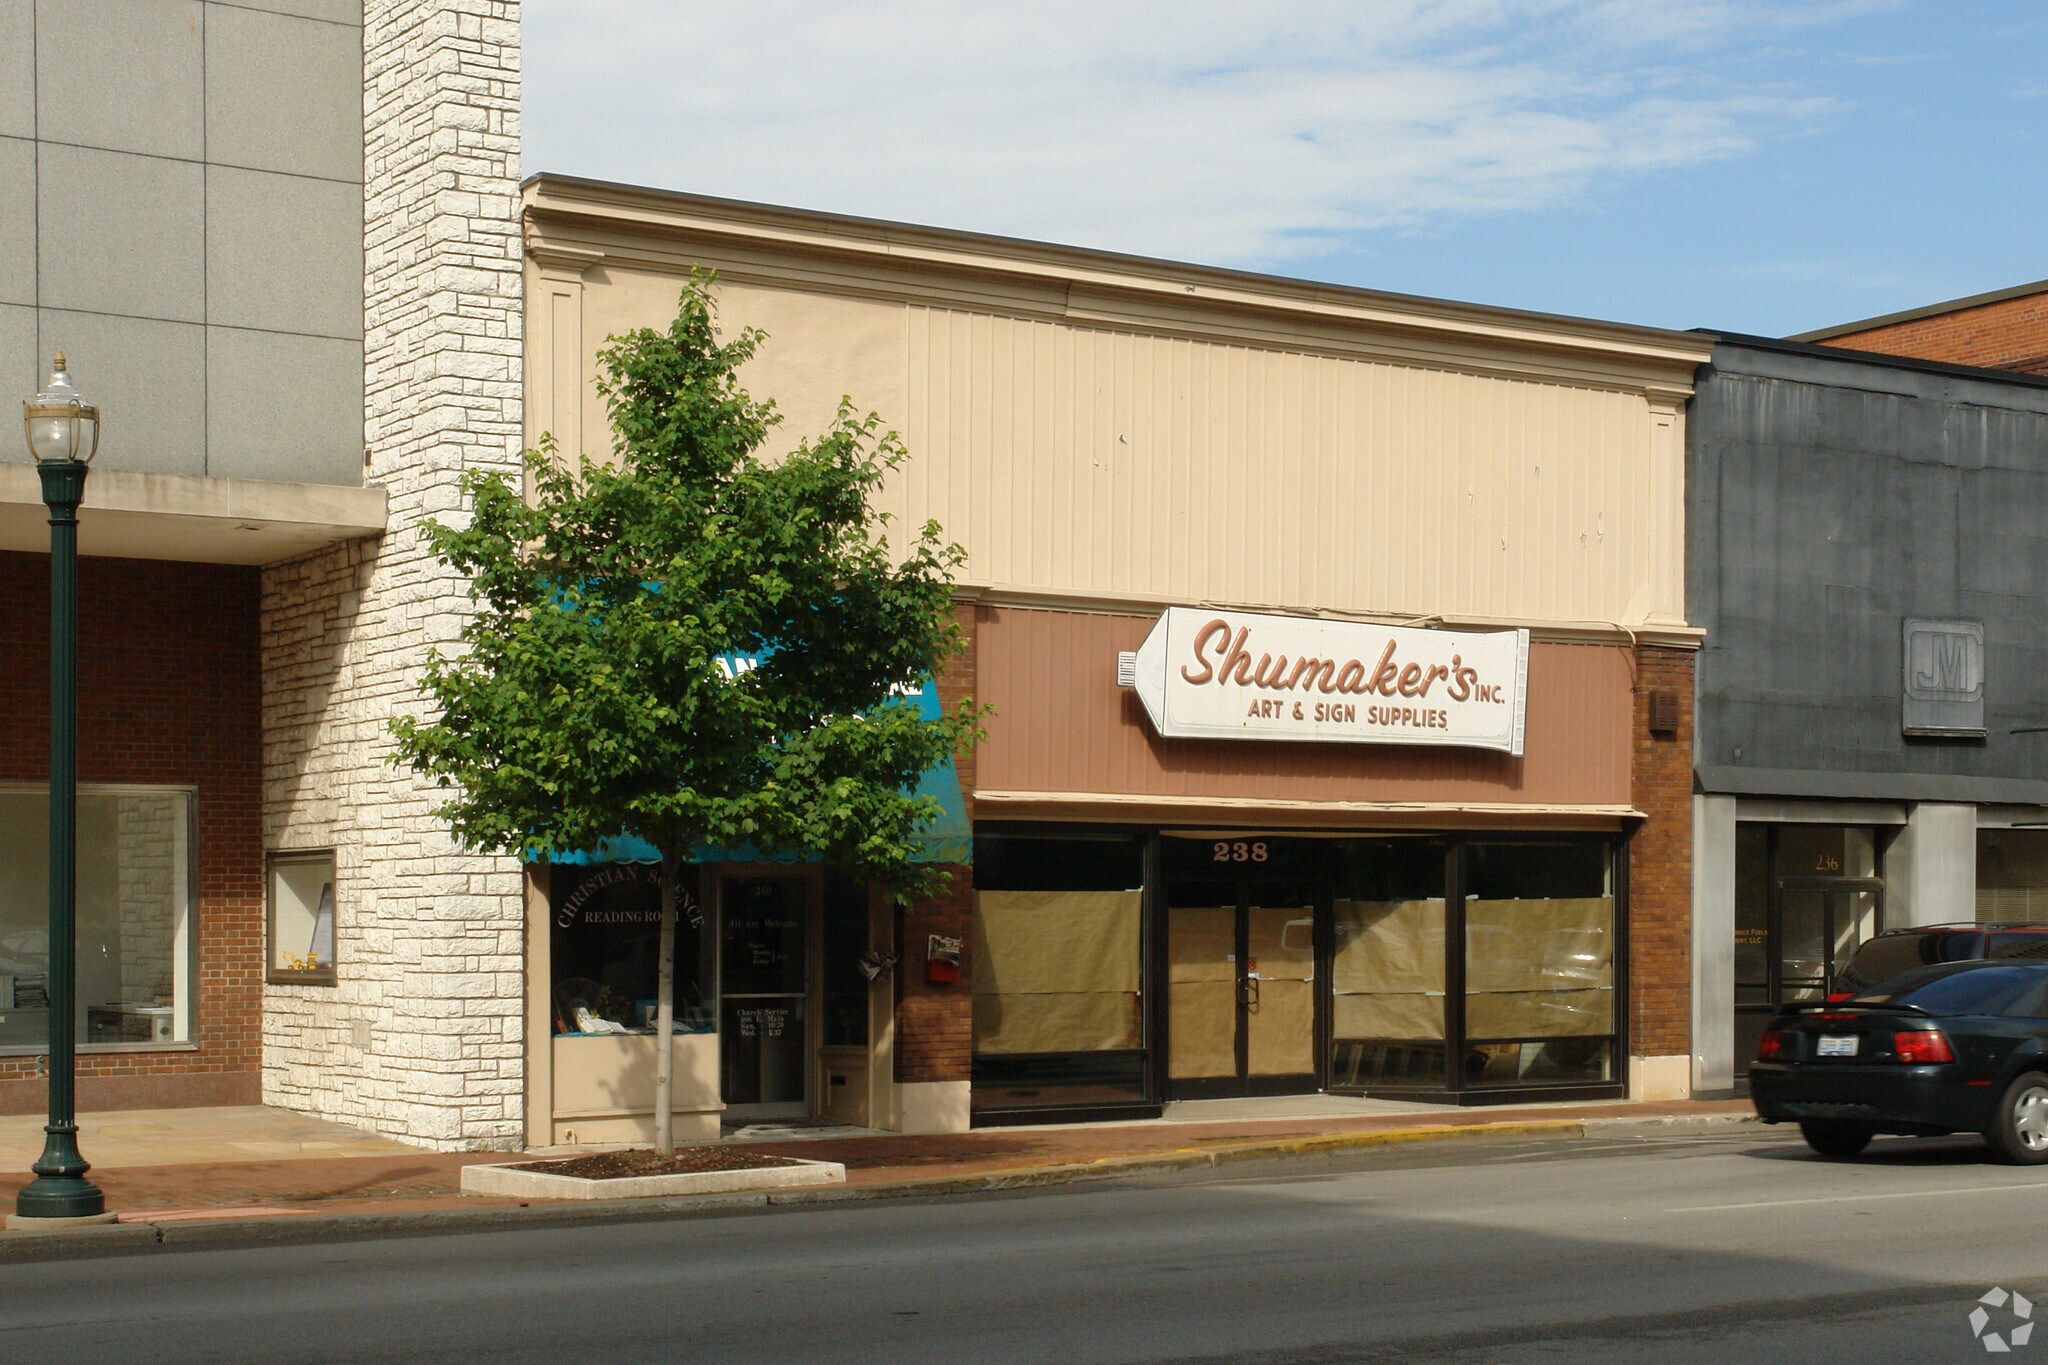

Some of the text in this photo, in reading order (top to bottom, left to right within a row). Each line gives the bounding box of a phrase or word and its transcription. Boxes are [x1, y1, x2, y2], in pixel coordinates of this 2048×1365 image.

[1181, 618, 1506, 705] Shumaker's INC.
[1248, 699, 1448, 729] ART & SIGN SUPPLIES
[1213, 842, 1268, 862] 238
[1816, 854, 1839, 871] 236
[557, 865, 706, 929] CHRISTIAN SCENCE
[584, 911, 680, 923] READING RO
[737, 1008, 762, 1016] Church
